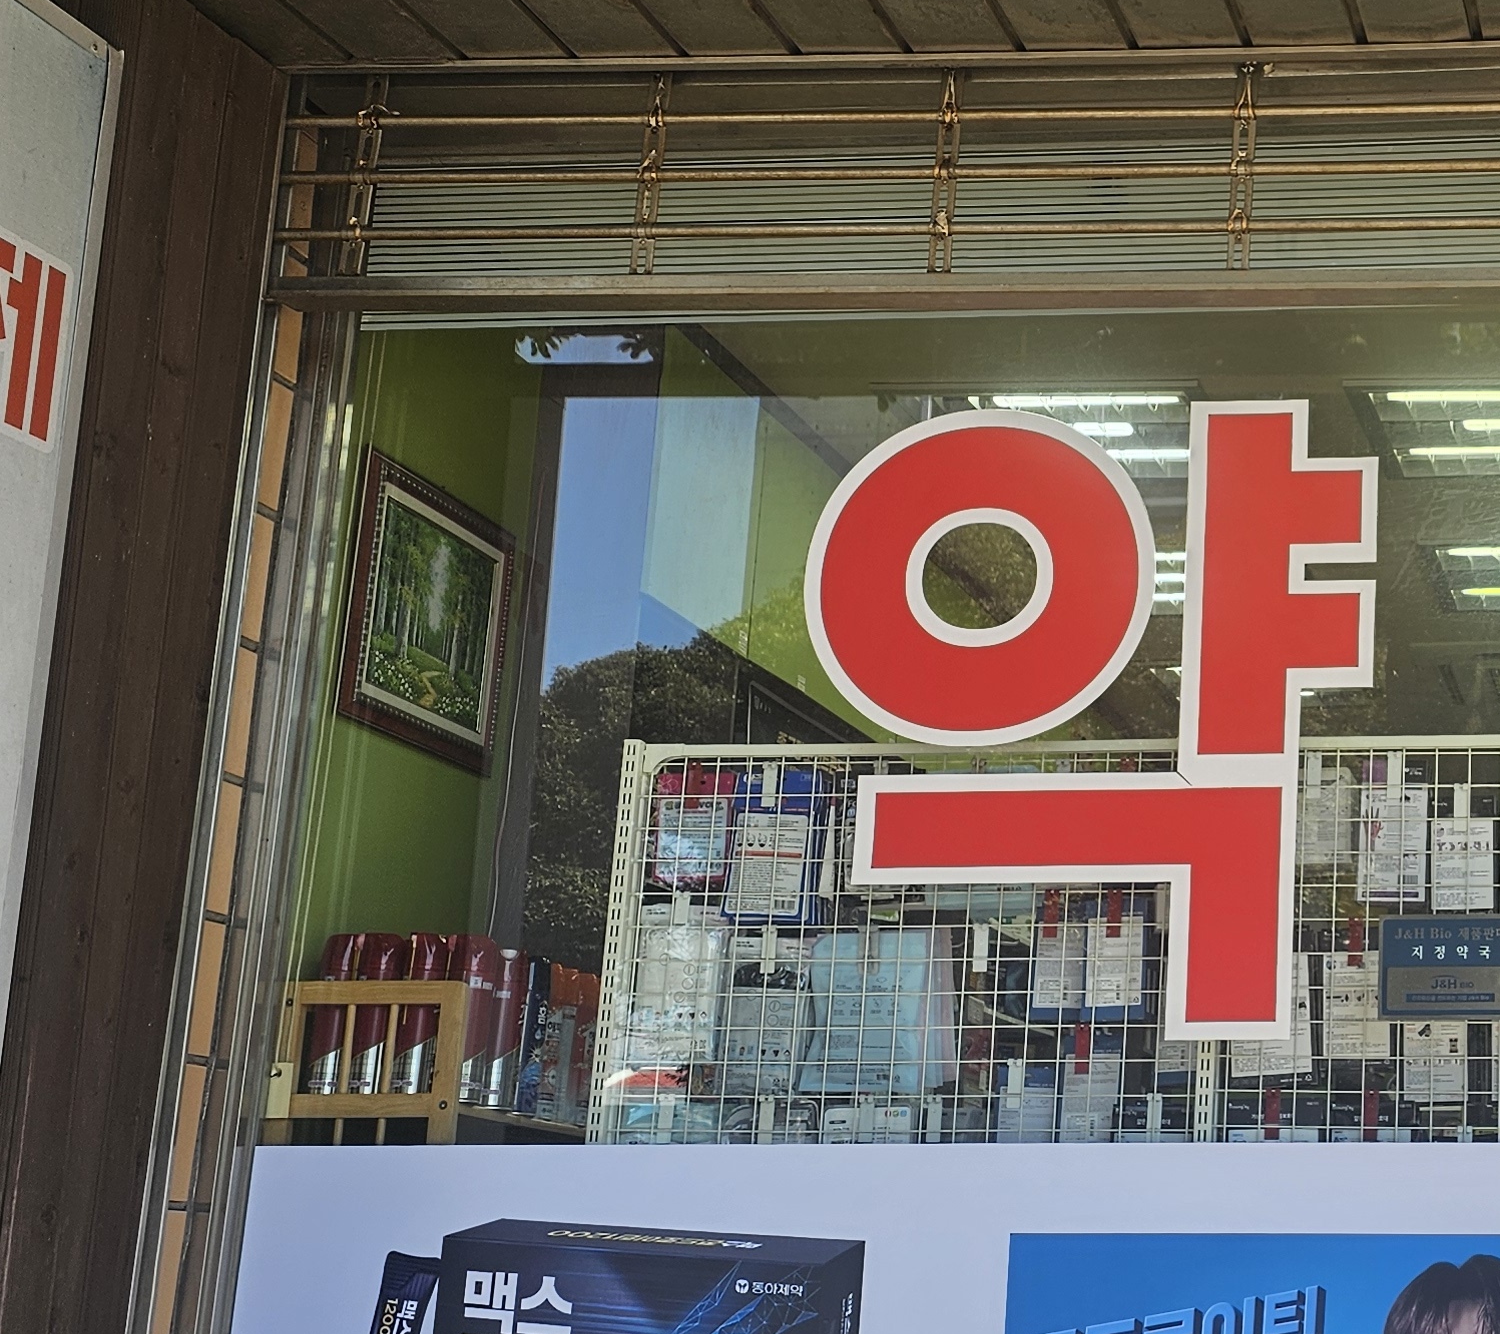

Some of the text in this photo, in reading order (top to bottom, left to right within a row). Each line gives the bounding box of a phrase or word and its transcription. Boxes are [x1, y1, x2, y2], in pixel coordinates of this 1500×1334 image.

[804, 399, 1379, 1041] 약
[1394, 927, 1425, 940] J&H
[1430, 927, 1452, 940] Bio
[1431, 979, 1457, 990] J&H
[751, 1281, 804, 1297] 동아제약
